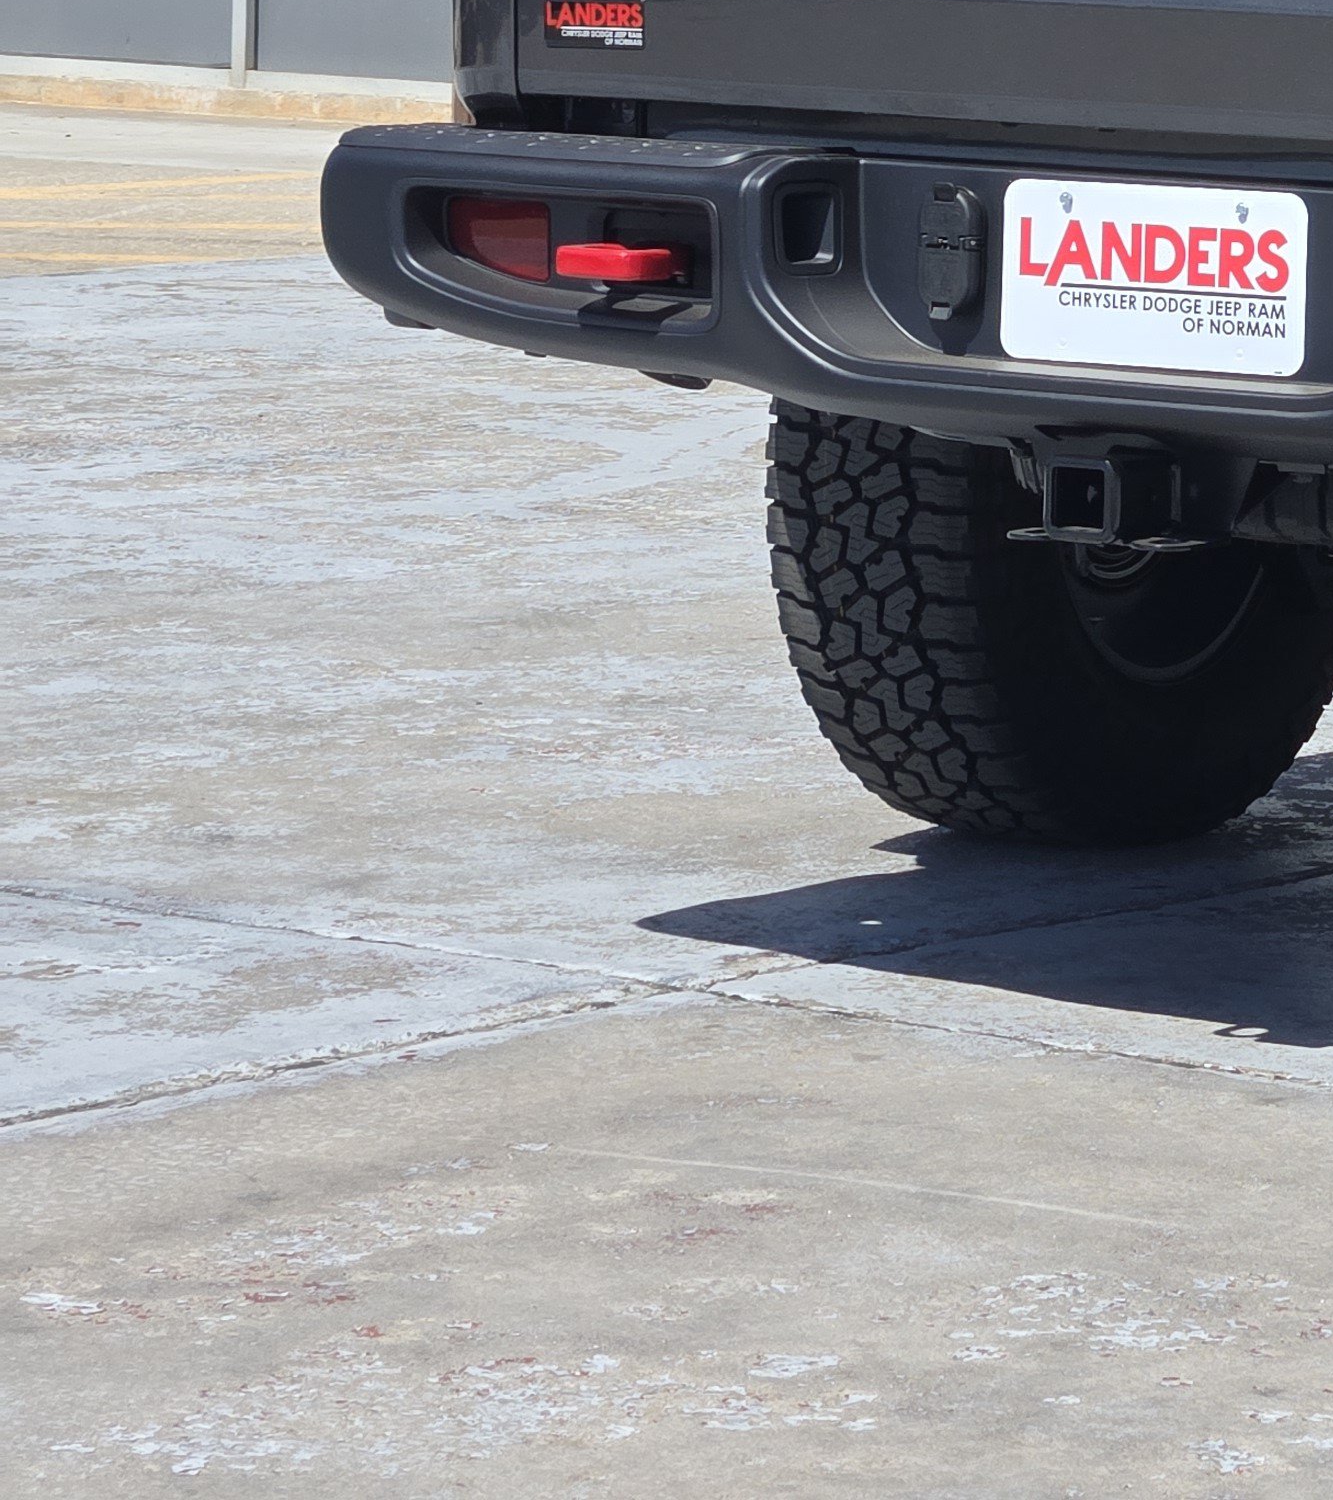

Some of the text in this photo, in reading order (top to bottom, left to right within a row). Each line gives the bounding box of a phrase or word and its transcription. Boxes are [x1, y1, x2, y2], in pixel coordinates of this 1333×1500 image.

[545, 0, 644, 29] LANDERS
[1019, 216, 1290, 294] LANDERS
[1058, 290, 1286, 320] CHRYSLER DODGE JEEP RAM
[1182, 317, 1287, 339] OF NORMAN
